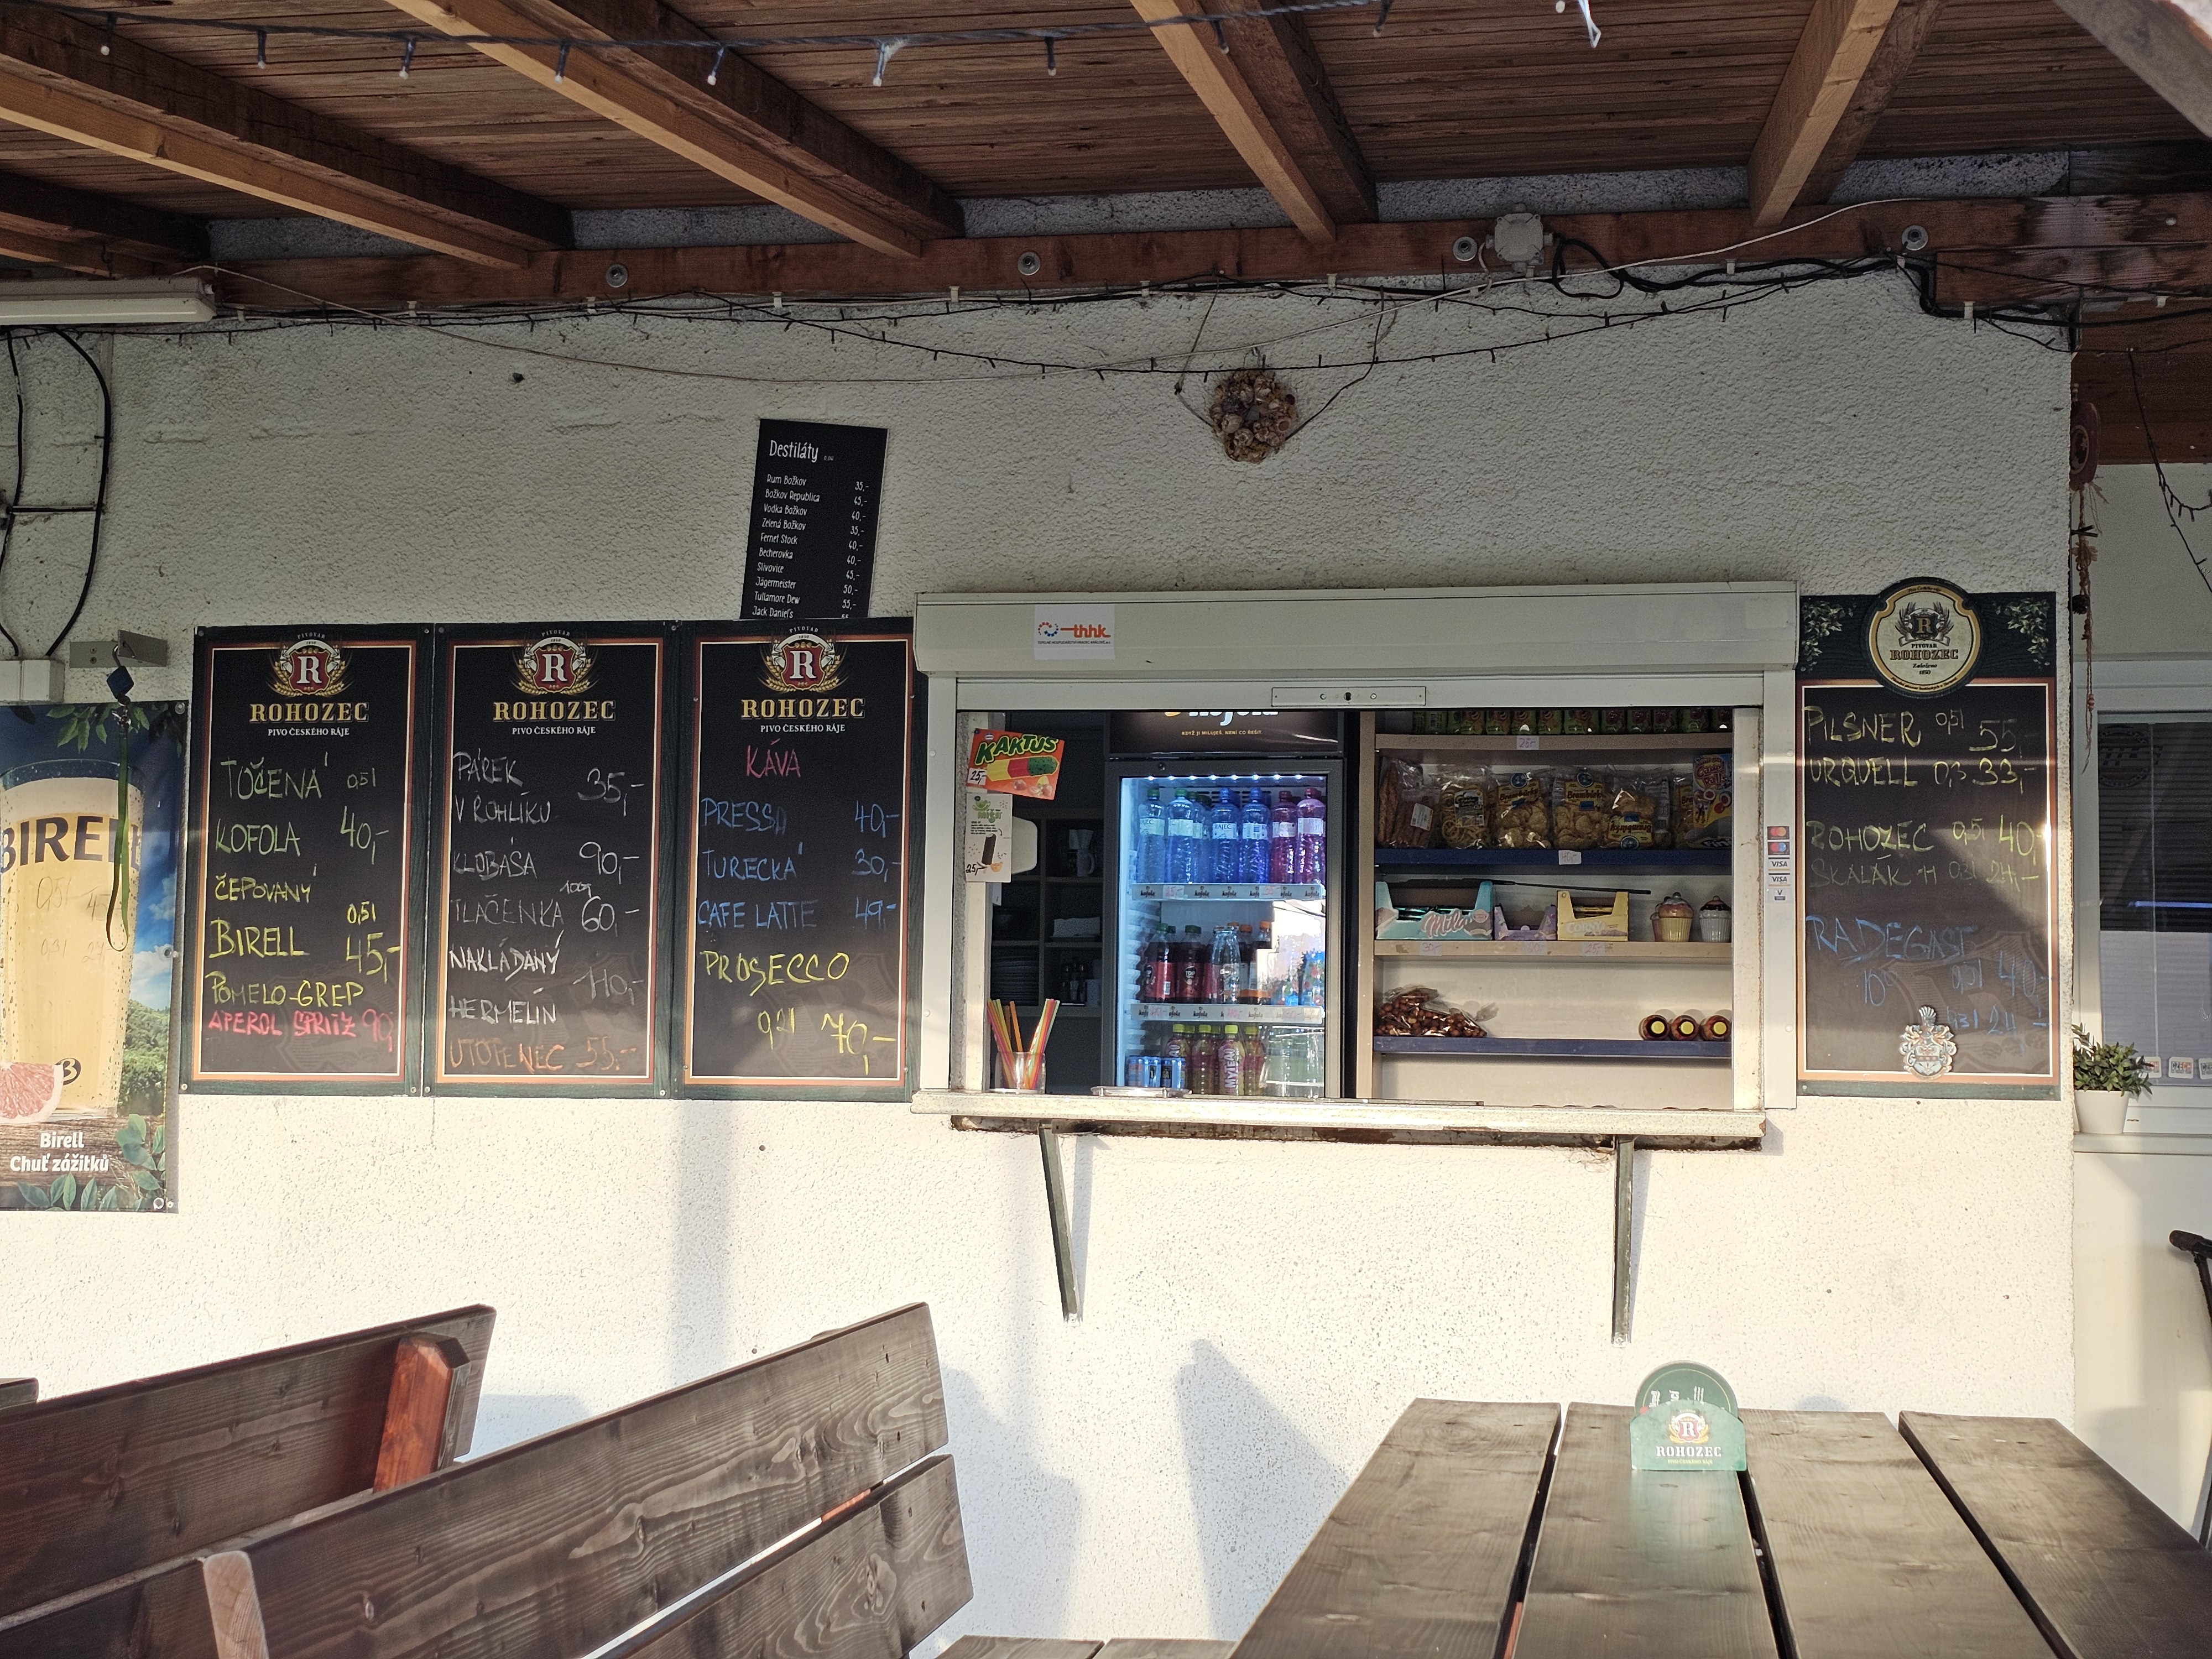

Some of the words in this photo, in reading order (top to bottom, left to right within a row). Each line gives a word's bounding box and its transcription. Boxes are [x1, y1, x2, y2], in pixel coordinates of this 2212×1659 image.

[769, 440, 818, 462] Destiláty
[767, 474, 781, 484] Rum
[784, 475, 806, 486] Božkov
[855, 482, 869, 492] 35,-
[765, 489, 787, 499] Božkov
[790, 491, 820, 503] Republica
[854, 496, 867, 506] 45,-
[764, 504, 782, 514] Vodka
[785, 505, 807, 515] Božkov
[852, 511, 866, 521] 40,-
[762, 518, 781, 529] Zelená
[784, 519, 806, 530] Božkov
[851, 526, 864, 536] 35,-
[761, 533, 779, 543] Fernet
[781, 534, 797, 545] Stock
[848, 541, 863, 550] 40,-
[759, 547, 793, 559] Becherovka
[847, 555, 861, 566] 40,-
[757, 562, 784, 573] Slivovice
[846, 571, 860, 580] 45,-
[755, 577, 796, 589] Jägermeister
[843, 585, 858, 595] 50,-
[752, 606, 768, 616] Jack
[754, 592, 785, 603] Tullamore
[787, 594, 800, 604] Dew
[842, 599, 857, 609] 55,-
[1916, 618, 1933, 633] R
[790, 651, 816, 679] R
[1890, 649, 1958, 660] ROHOZEC
[297, 656, 321, 684] R
[541, 654, 567, 682] R
[249, 702, 369, 723] ROHOZEC
[493, 701, 616, 722] ROHOZEC
[741, 698, 865, 719] ROHOZEC
[289, 727, 328, 736] ČESKÉHO
[331, 727, 349, 737] RÁJE
[512, 727, 533, 735] PIVO
[534, 726, 574, 734] ČESKÉHO
[576, 726, 596, 735] RÁJE
[782, 723, 823, 732] ČESKÉHO
[826, 724, 845, 733] RÁJE
[1802, 706, 1921, 747] PILSNER
[746, 738, 800, 778] KÁVA
[974, 734, 1058, 765] KAKTUS
[221, 752, 328, 800] TOČENÁ
[1809, 755, 1918, 787] URQUELL
[455, 795, 465, 823] V
[216, 819, 300, 856] KOFOLA
[1806, 820, 1934, 852] ROHOZEC
[453, 836, 537, 880] KLOBÁSA
[215, 864, 317, 903] ČEPOVANÝ
[697, 900, 745, 928] CAFE
[756, 900, 818, 929] LATTE
[209, 917, 310, 958] BIRELL
[1566, 921, 1605, 933] CORNY
[700, 951, 849, 996] PROSECCO
[208, 1011, 283, 1036] APEROL
[40, 1131, 85, 1148] Birell
[9, 1155, 50, 1172] Chuť
[51, 1153, 109, 1172] zážitků
[1682, 1422, 1696, 1437] R
[1656, 1446, 1721, 1457] ROHOZEC
